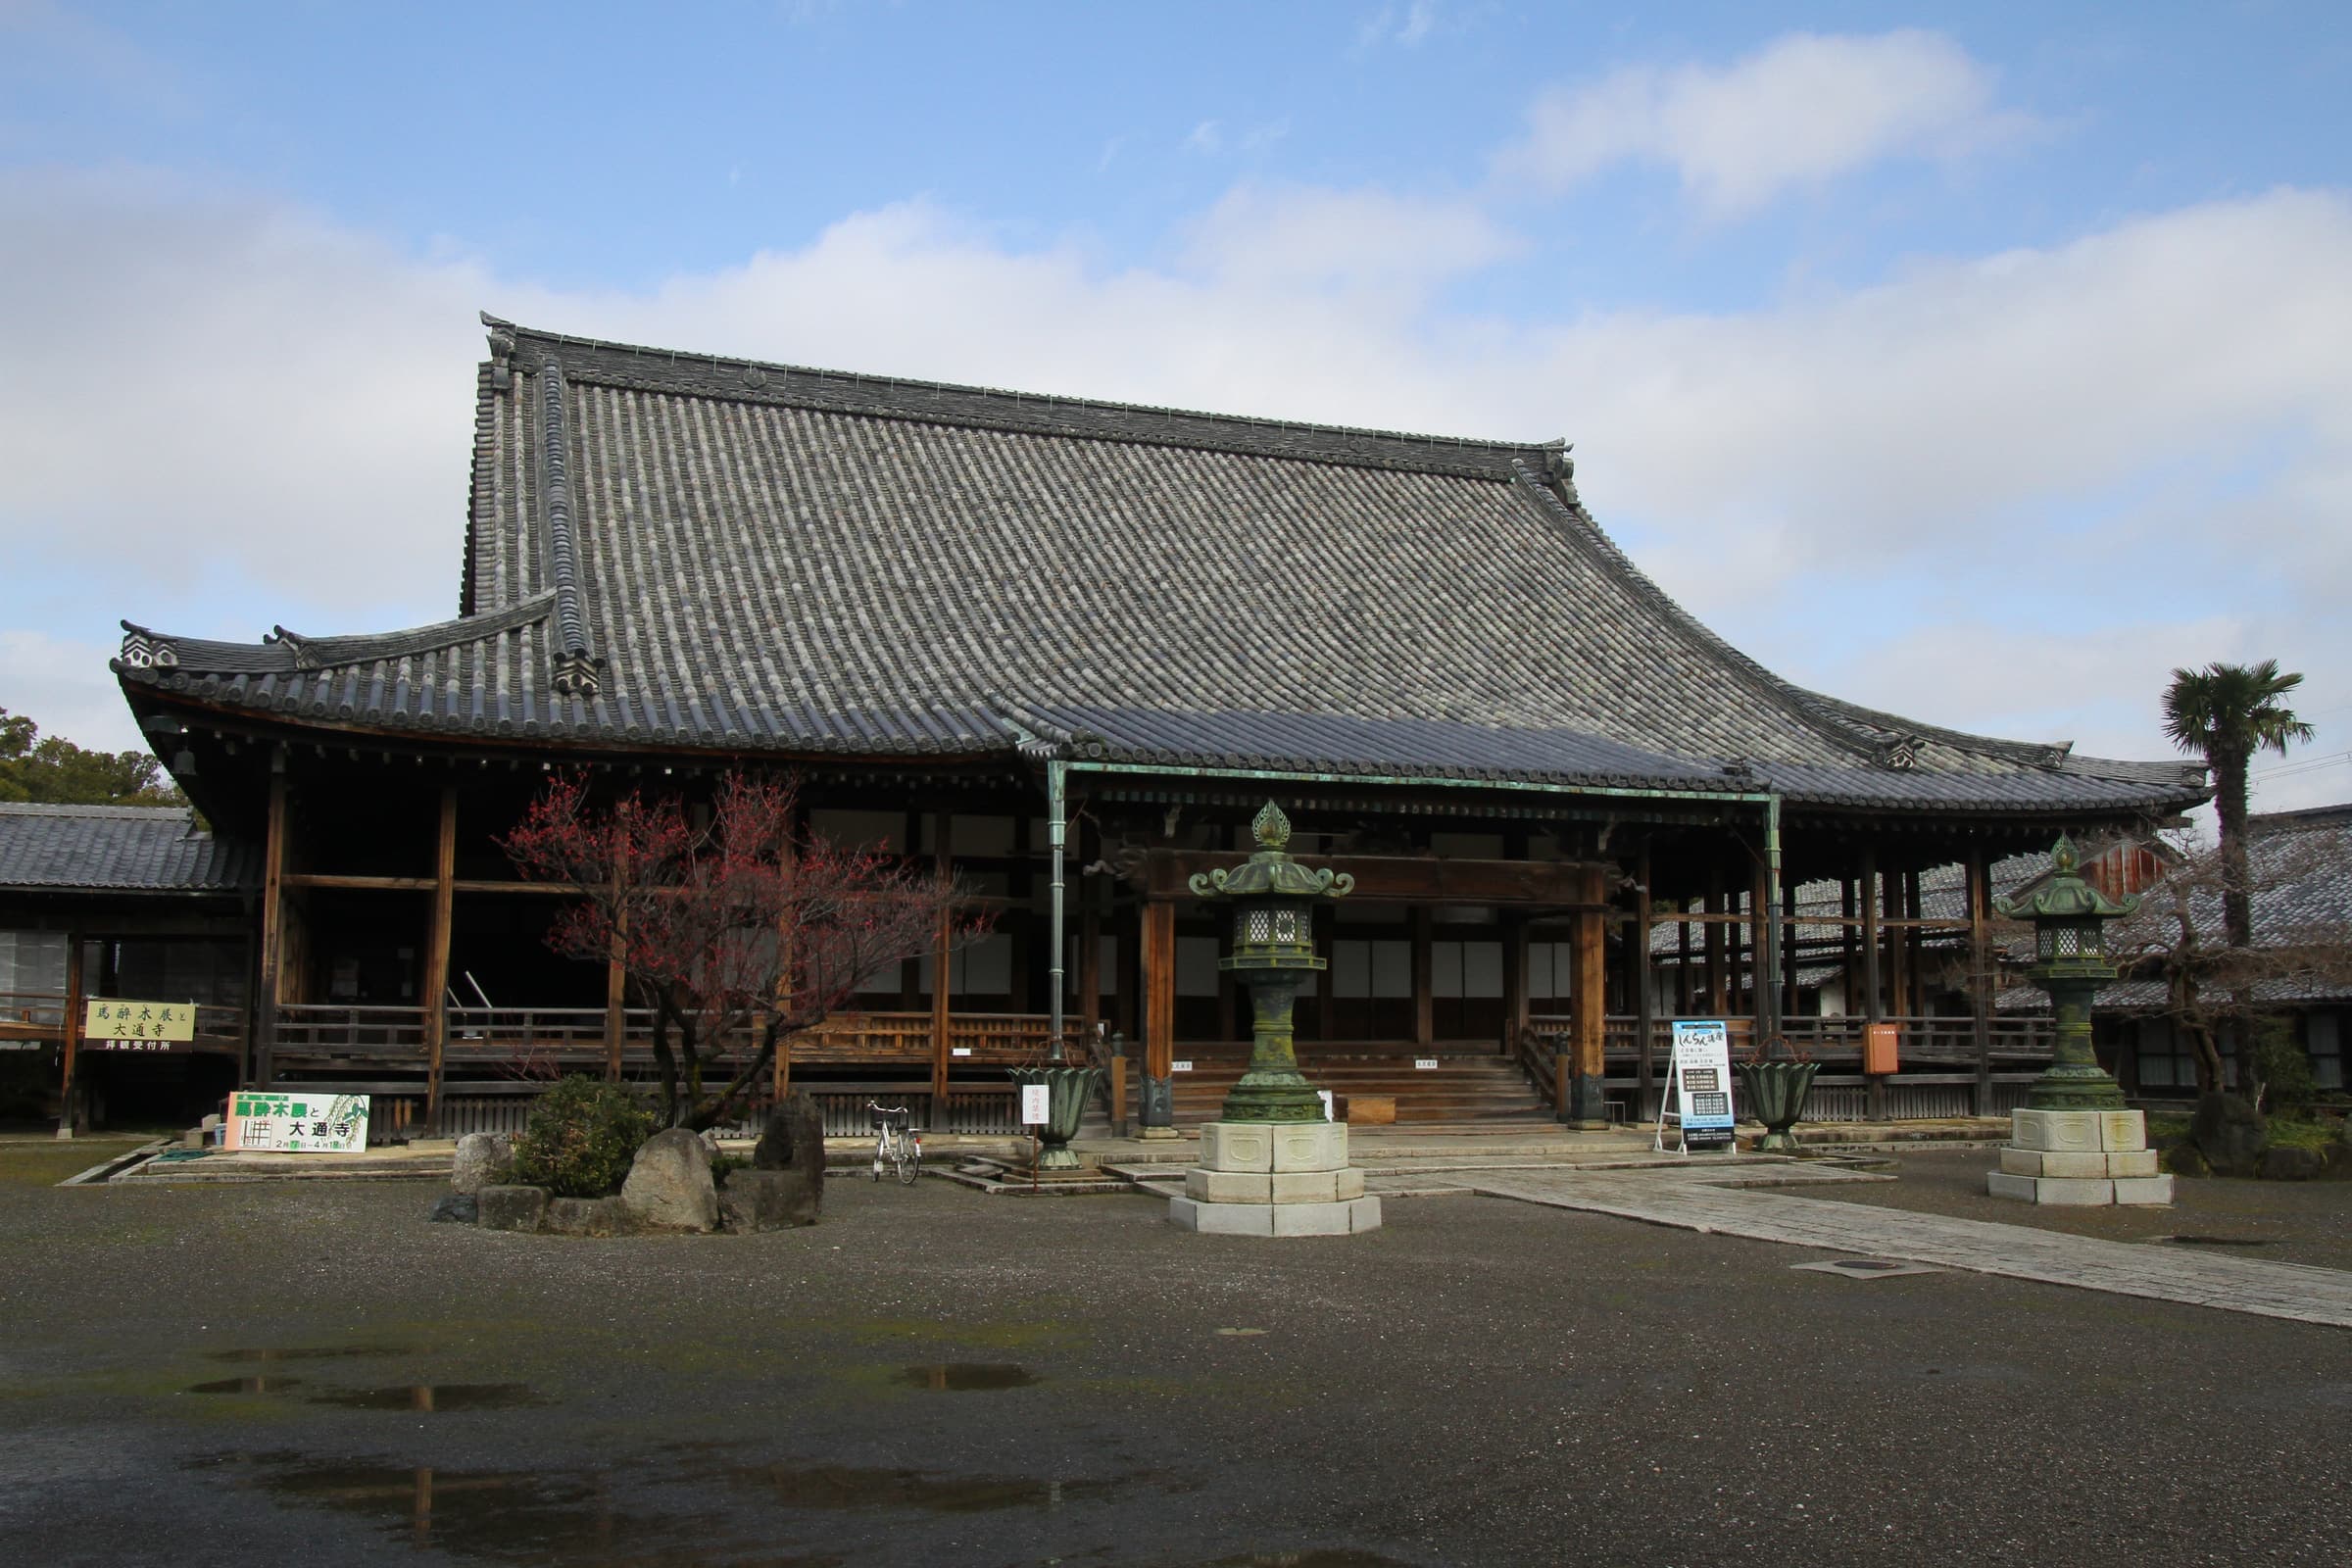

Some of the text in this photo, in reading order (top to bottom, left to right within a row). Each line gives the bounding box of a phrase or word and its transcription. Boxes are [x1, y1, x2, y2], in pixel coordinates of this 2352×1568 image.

[113, 1022, 165, 1037] 大通寺
[105, 1040, 171, 1051] 拝観受付所
[289, 1121, 351, 1137] 大通寺
